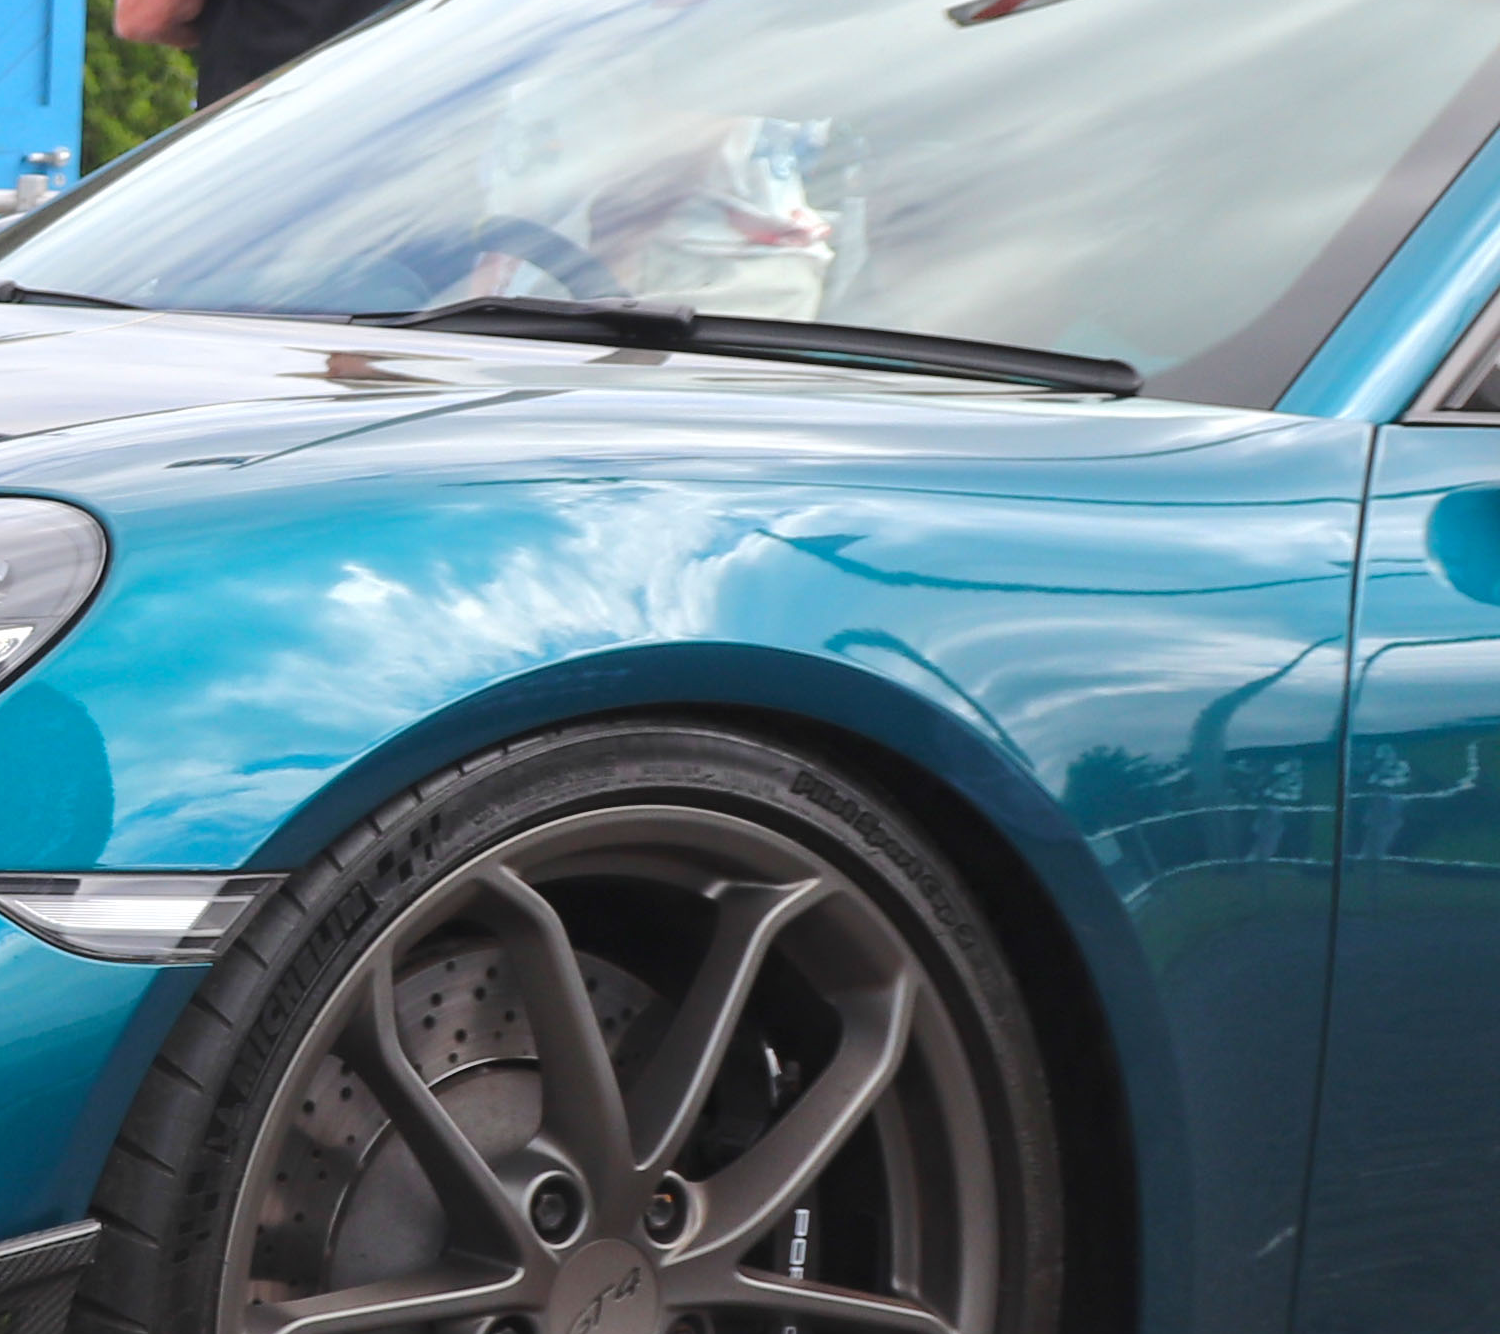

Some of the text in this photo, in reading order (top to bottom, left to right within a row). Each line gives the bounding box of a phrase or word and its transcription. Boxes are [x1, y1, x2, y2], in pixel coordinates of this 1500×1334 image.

[790, 770, 859, 824] Pilot
[853, 810, 923, 881] Sport
[917, 873, 957, 927] Cup
[228, 880, 378, 1103] MICHELIN
